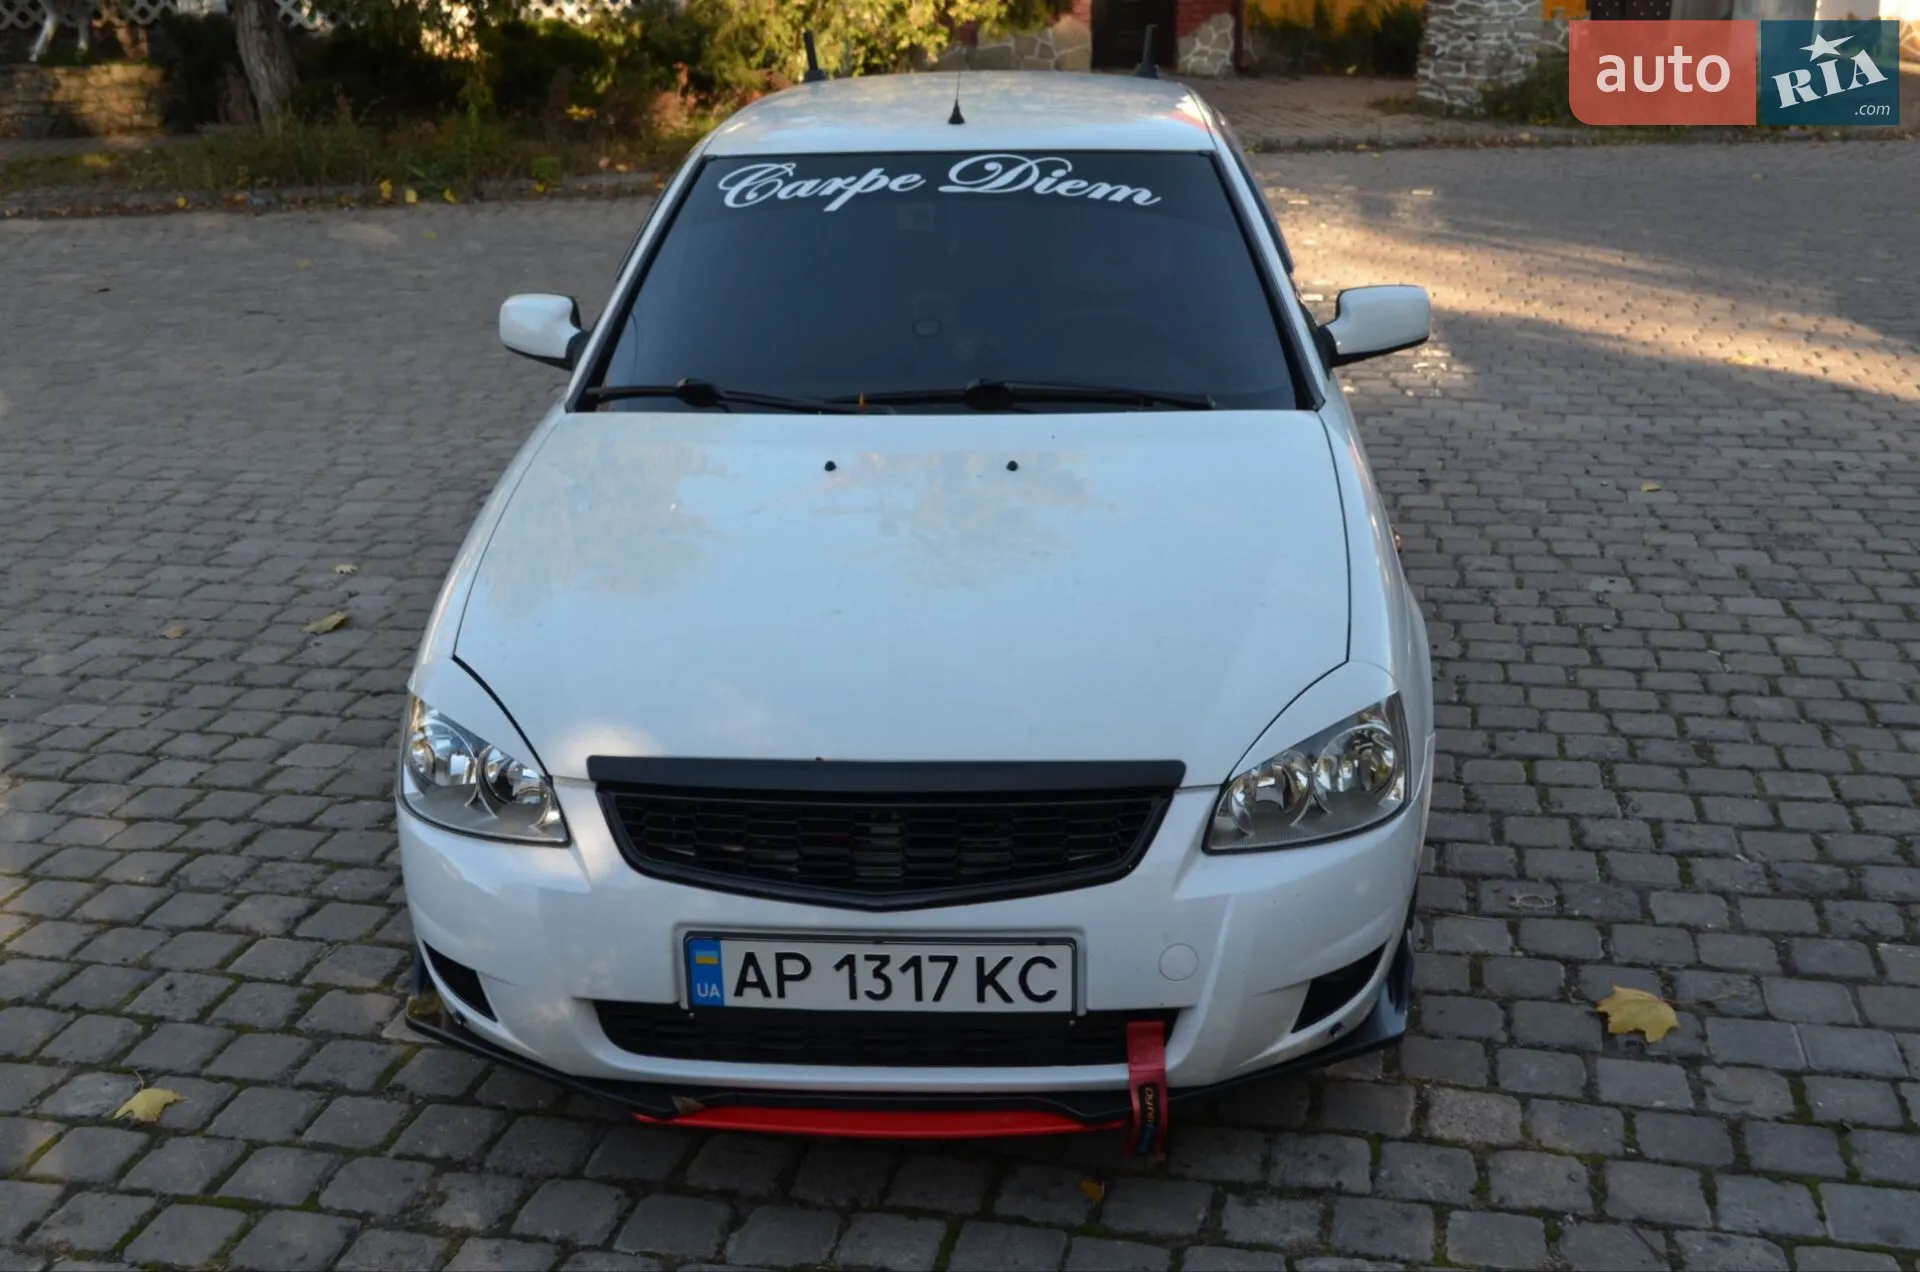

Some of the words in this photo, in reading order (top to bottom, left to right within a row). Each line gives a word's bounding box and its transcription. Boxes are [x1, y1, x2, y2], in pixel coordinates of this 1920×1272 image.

[718, 162, 927, 212] Carpe
[938, 153, 1162, 206] Diem
[697, 983, 721, 999] UA
[733, 952, 812, 1000] AP
[832, 953, 958, 1002] 1317
[976, 955, 1058, 1004] KC
